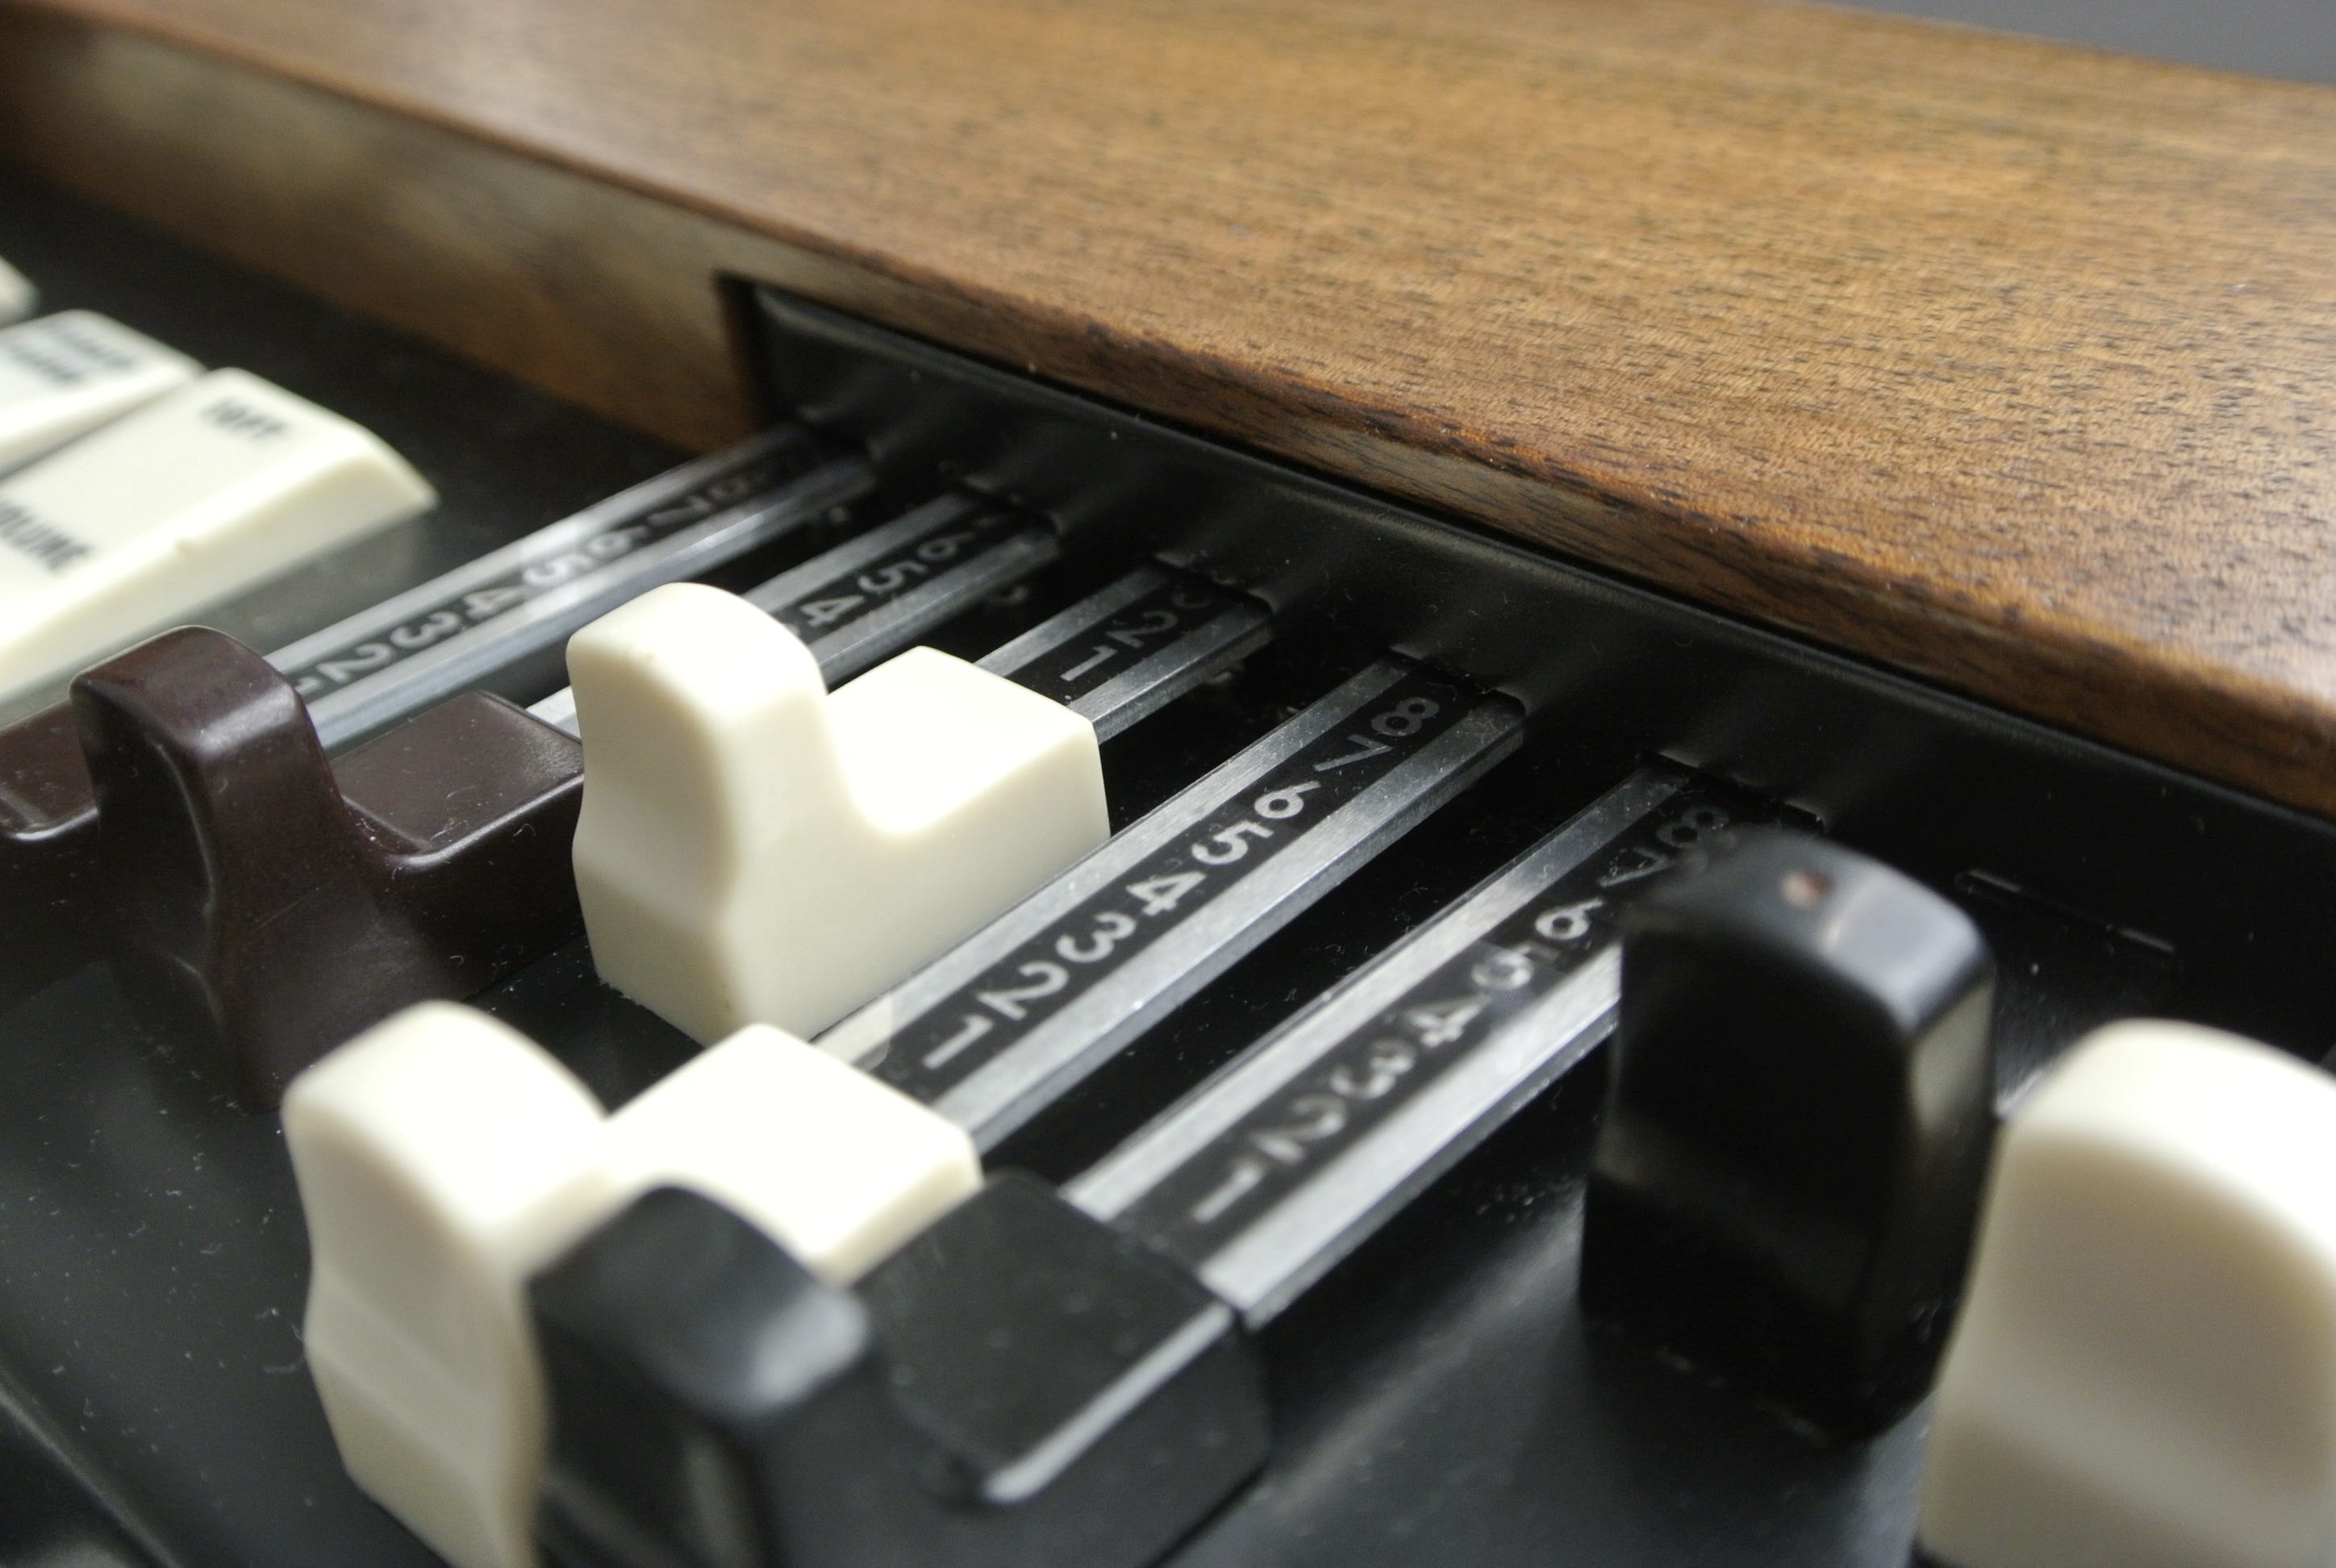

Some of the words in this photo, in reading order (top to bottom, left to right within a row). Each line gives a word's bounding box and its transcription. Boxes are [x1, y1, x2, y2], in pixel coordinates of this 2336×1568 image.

[800, 594, 865, 628] 4
[857, 560, 927, 594] 5
[916, 532, 976, 561] 6
[315, 643, 393, 682] 2
[390, 610, 462, 649] 3
[462, 586, 526, 620] 4
[1060, 645, 1117, 682] 1
[1105, 610, 1178, 648] 2
[922, 1014, 994, 1070] 1
[975, 961, 1070, 1020] 2
[1054, 911, 1137, 962] 3
[1126, 871, 1207, 916] 4
[1191, 819, 1274, 865] 5
[1254, 781, 1321, 819] 6
[1312, 734, 1394, 771] 7
[1371, 697, 1440, 736] 8
[1192, 1157, 1264, 1222] 1
[1253, 1094, 1347, 1164] 2
[1329, 1038, 1416, 1100] 3
[1407, 992, 1491, 1047] 4
[1535, 897, 1604, 940] 6
[1597, 846, 1675, 888] 7
